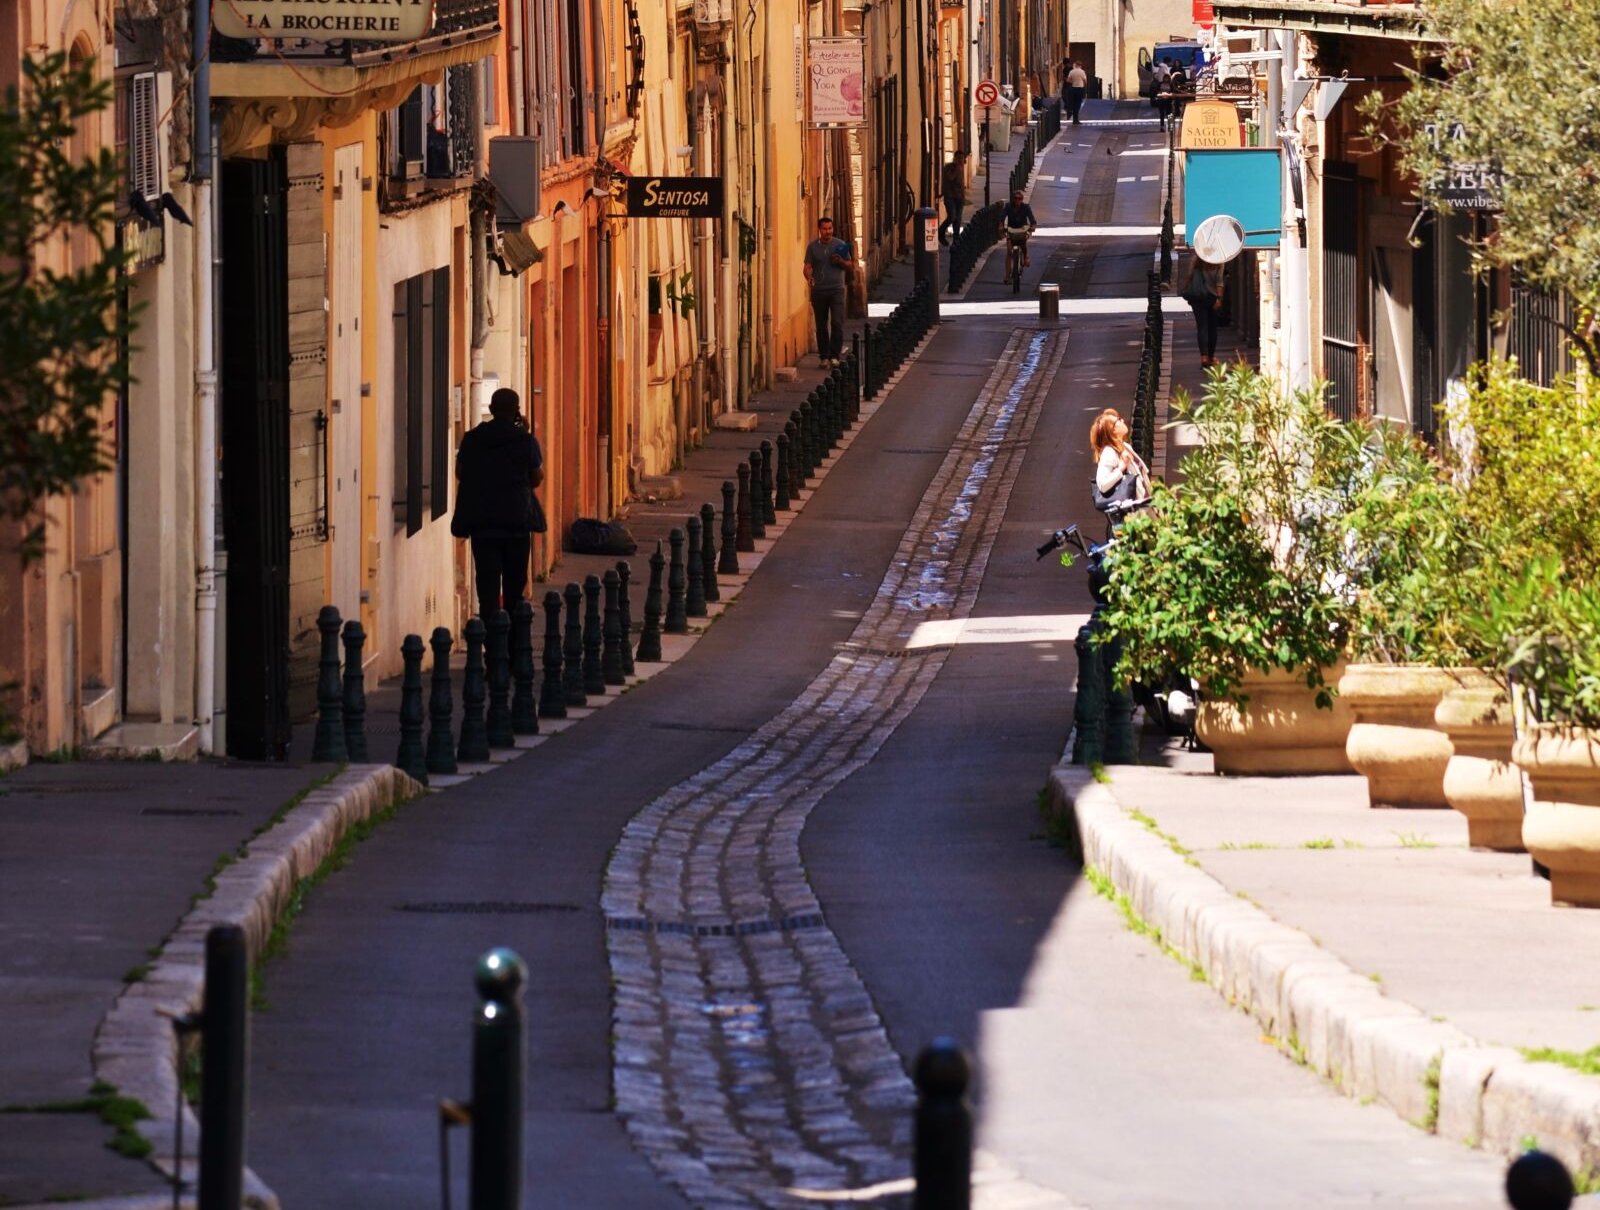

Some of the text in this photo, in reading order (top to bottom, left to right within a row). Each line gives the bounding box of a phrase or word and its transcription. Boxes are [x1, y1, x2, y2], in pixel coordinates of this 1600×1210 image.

[246, 14, 400, 31] LA BROCHERIE
[1187, 127, 1234, 137] SAGEST
[1194, 137, 1227, 147] IMMO
[643, 179, 709, 207] SENTOSA
[659, 208, 690, 217] COIFFURE
